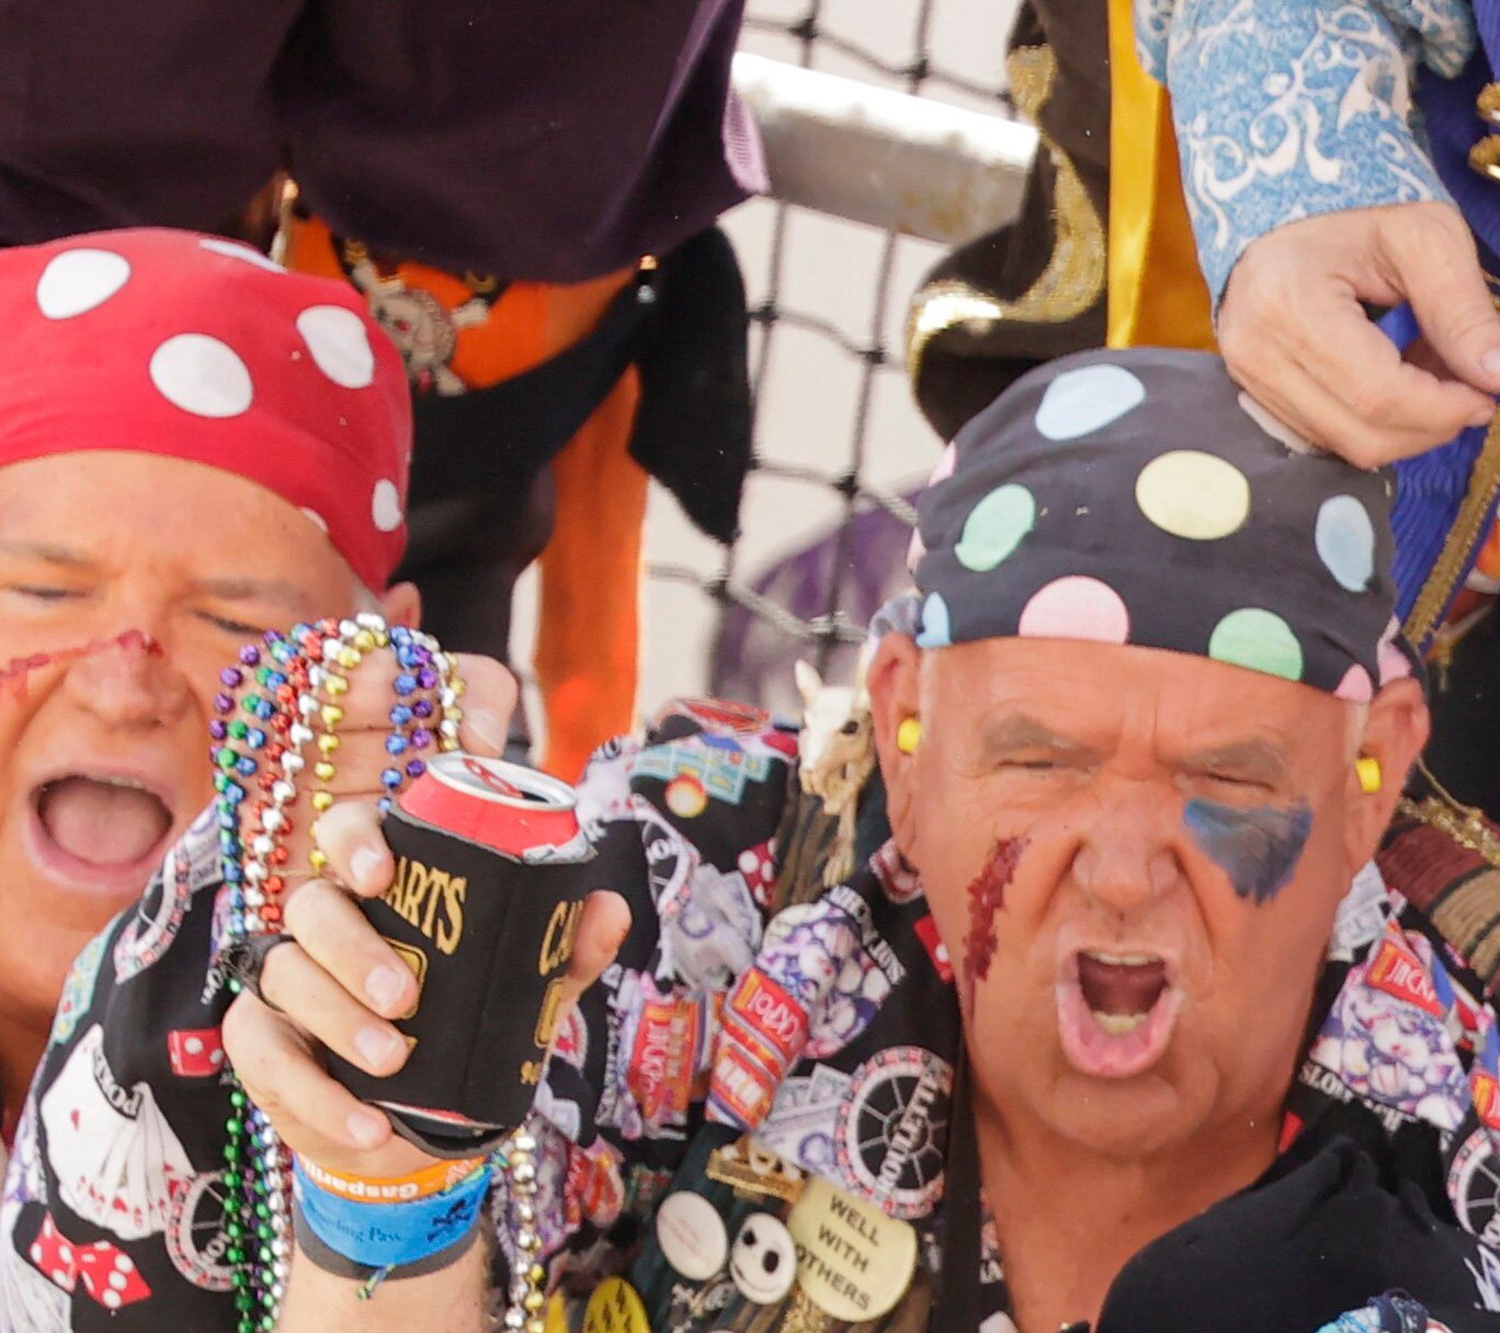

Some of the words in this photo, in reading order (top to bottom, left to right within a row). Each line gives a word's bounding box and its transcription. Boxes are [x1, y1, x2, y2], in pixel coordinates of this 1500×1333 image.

[817, 1222, 870, 1274] WITH
[829, 1193, 881, 1248] WELL
[796, 1243, 871, 1311] OTHERS
